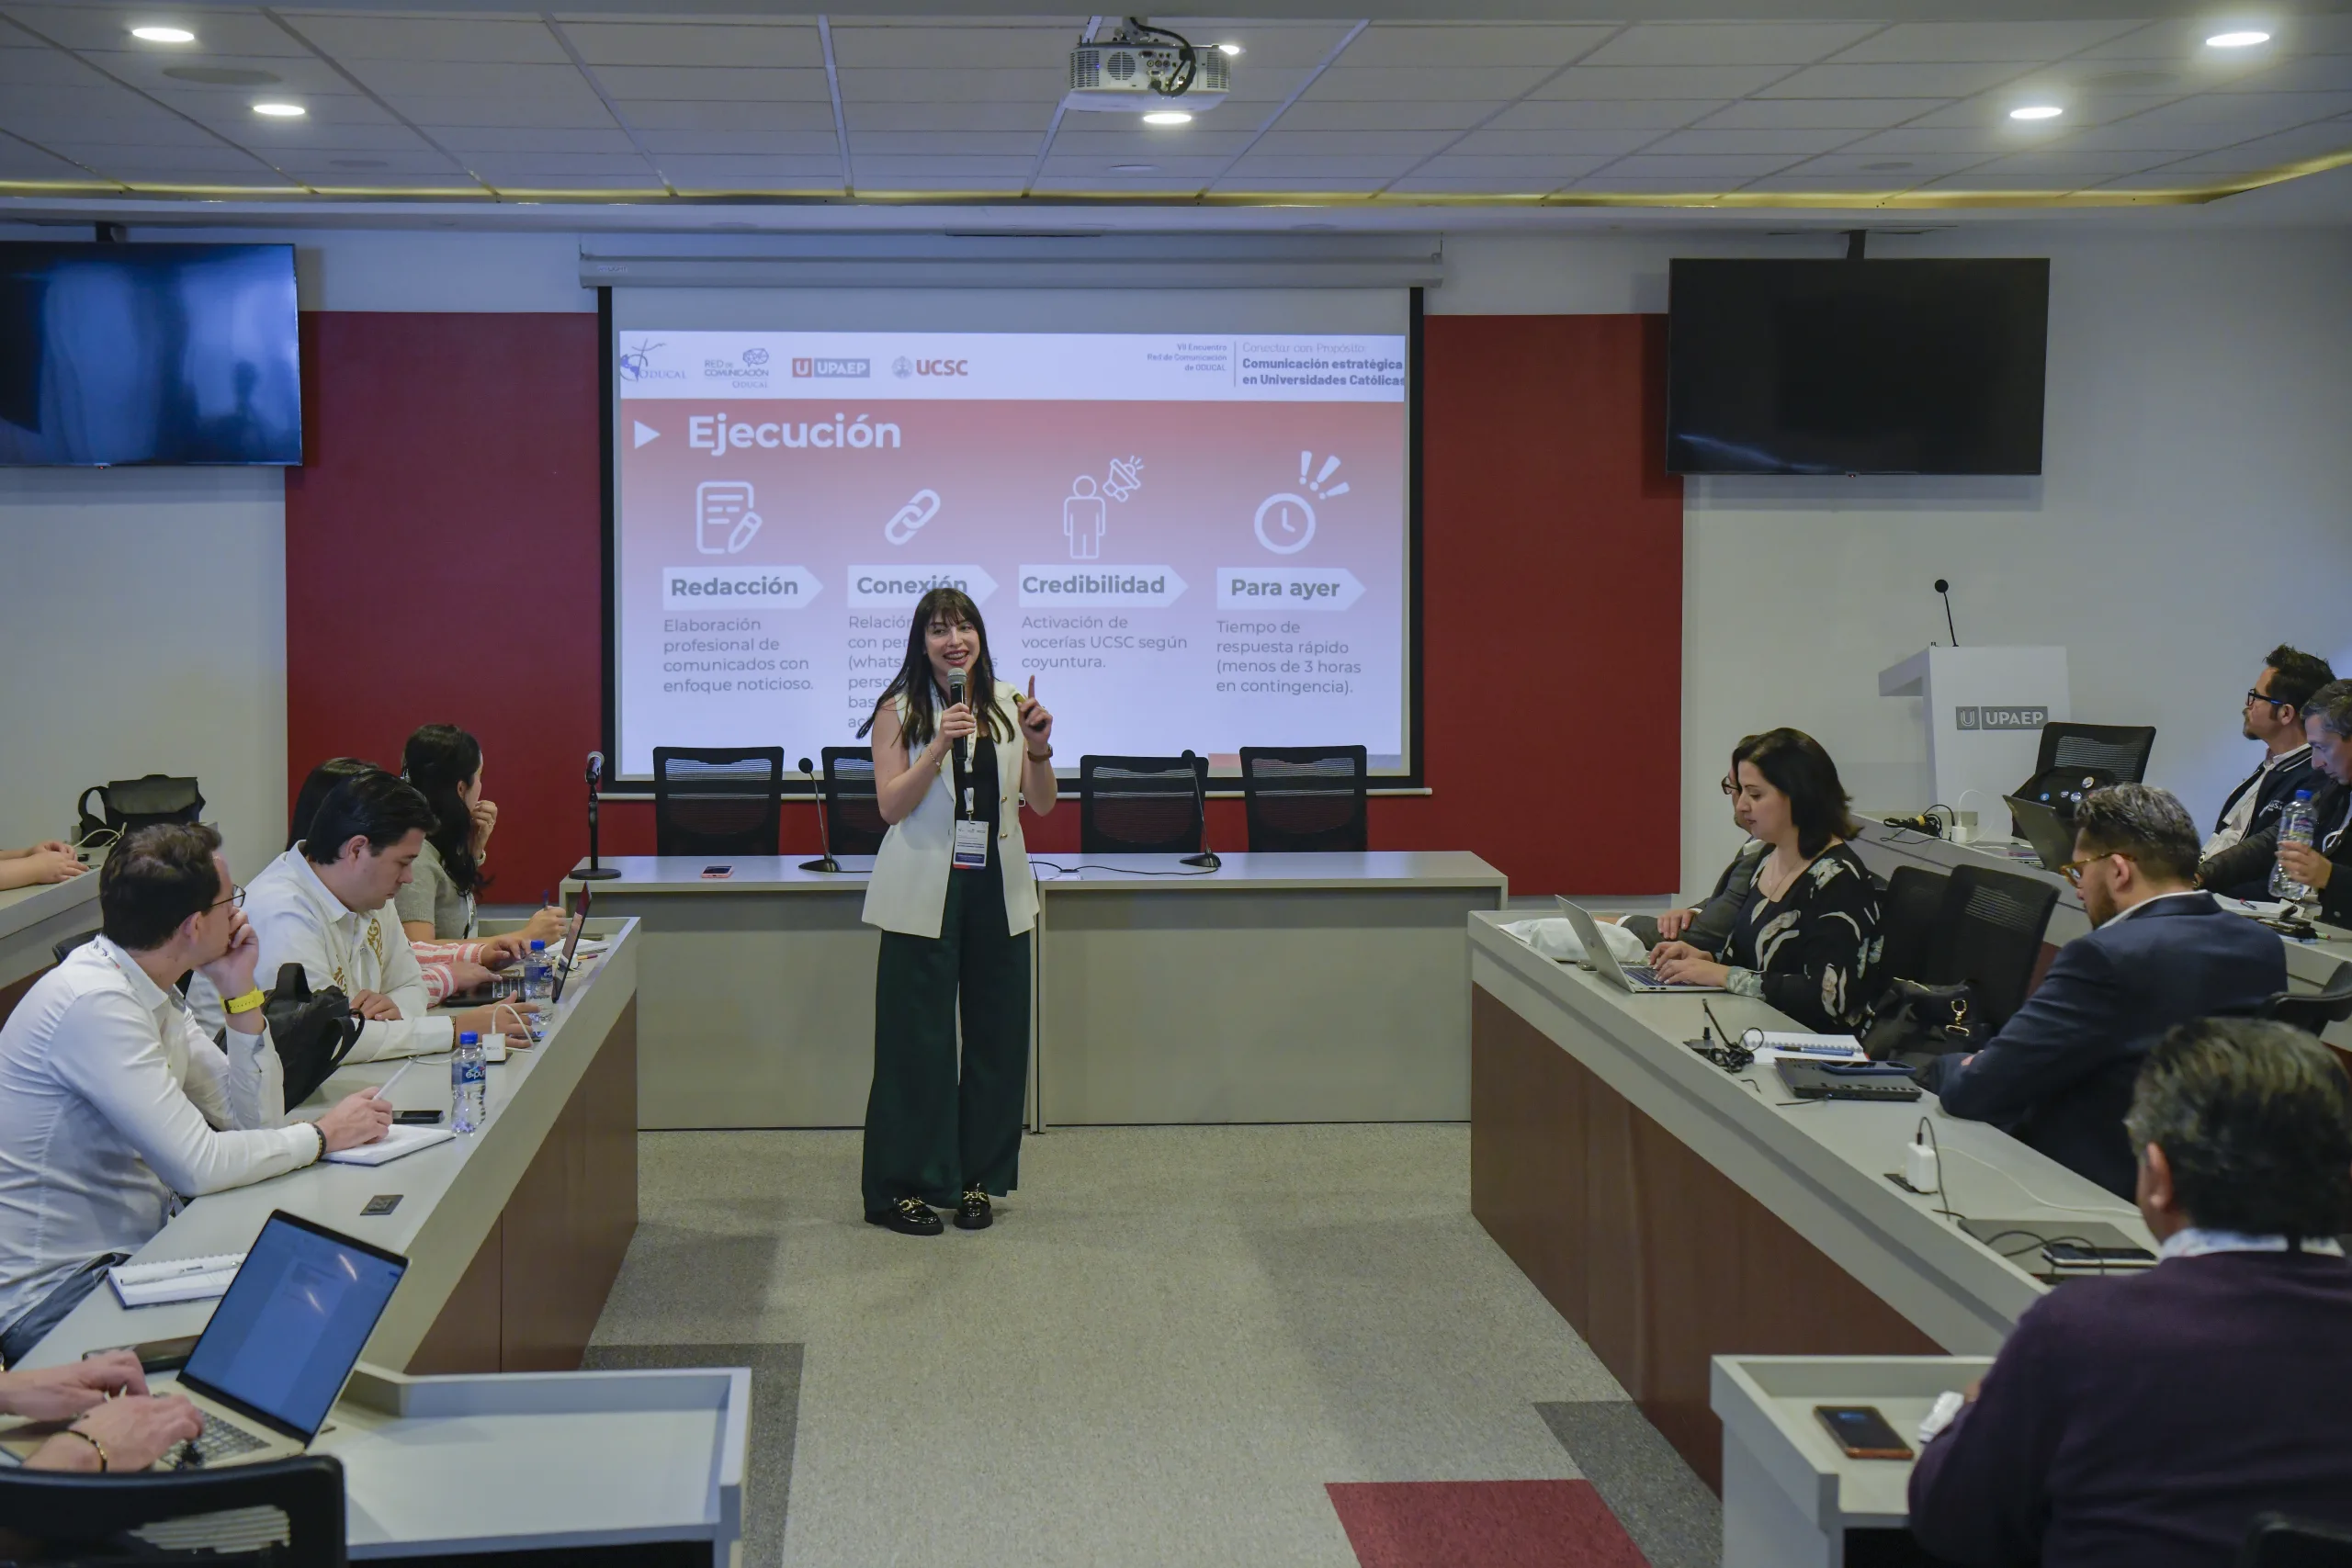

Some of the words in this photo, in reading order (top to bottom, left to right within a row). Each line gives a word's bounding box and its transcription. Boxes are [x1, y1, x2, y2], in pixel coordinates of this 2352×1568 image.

[1188, 343, 1227, 351] Encuentro
[1242, 342, 1290, 354] Conectar
[1294, 344, 1313, 354] con
[705, 359, 724, 368] RED
[1174, 354, 1227, 362] Comunicación
[1242, 357, 1329, 369] Comunicación
[1331, 358, 1403, 372] estratégica
[639, 369, 687, 379] ODUCAL
[704, 367, 769, 377] COMUNICACIÓN
[817, 361, 866, 375] UPAEP
[916, 359, 968, 377] UCSC
[1242, 377, 1258, 385] en
[1260, 374, 1347, 386] Universidades
[689, 412, 901, 457] Ejecución
[671, 576, 798, 596] Redacción
[1023, 575, 1165, 594] Credibilidad
[1231, 579, 1283, 597] Para
[1289, 581, 1340, 601] ayer
[663, 617, 761, 633] Elaboración
[1022, 615, 1103, 629] Activación
[1108, 615, 1128, 629] de
[1216, 620, 1276, 637] Tiempo
[1280, 620, 1301, 634] de
[663, 637, 754, 655] profesional
[759, 637, 779, 651] de
[848, 639, 876, 649] con
[1022, 635, 1086, 649] vocerías
[1091, 636, 1135, 649] UCSC
[1138, 636, 1188, 653] según
[1216, 640, 1294, 657] respuesta
[1298, 639, 1350, 657] rápido
[663, 657, 775, 673] comunicados
[779, 658, 809, 671] con
[848, 654, 904, 671] (whats
[1022, 656, 1106, 672] coyuntura.
[1216, 659, 1276, 675] (menos
[1281, 660, 1301, 673] de
[1304, 660, 1314, 673] 3
[1317, 660, 1362, 674] horas
[663, 678, 732, 695] enfoque
[737, 677, 814, 692] noticioso.
[848, 678, 891, 691] perso
[1216, 682, 1237, 693] en
[1240, 679, 1353, 696] contingencia).
[1985, 711, 2044, 725] UPAEP
